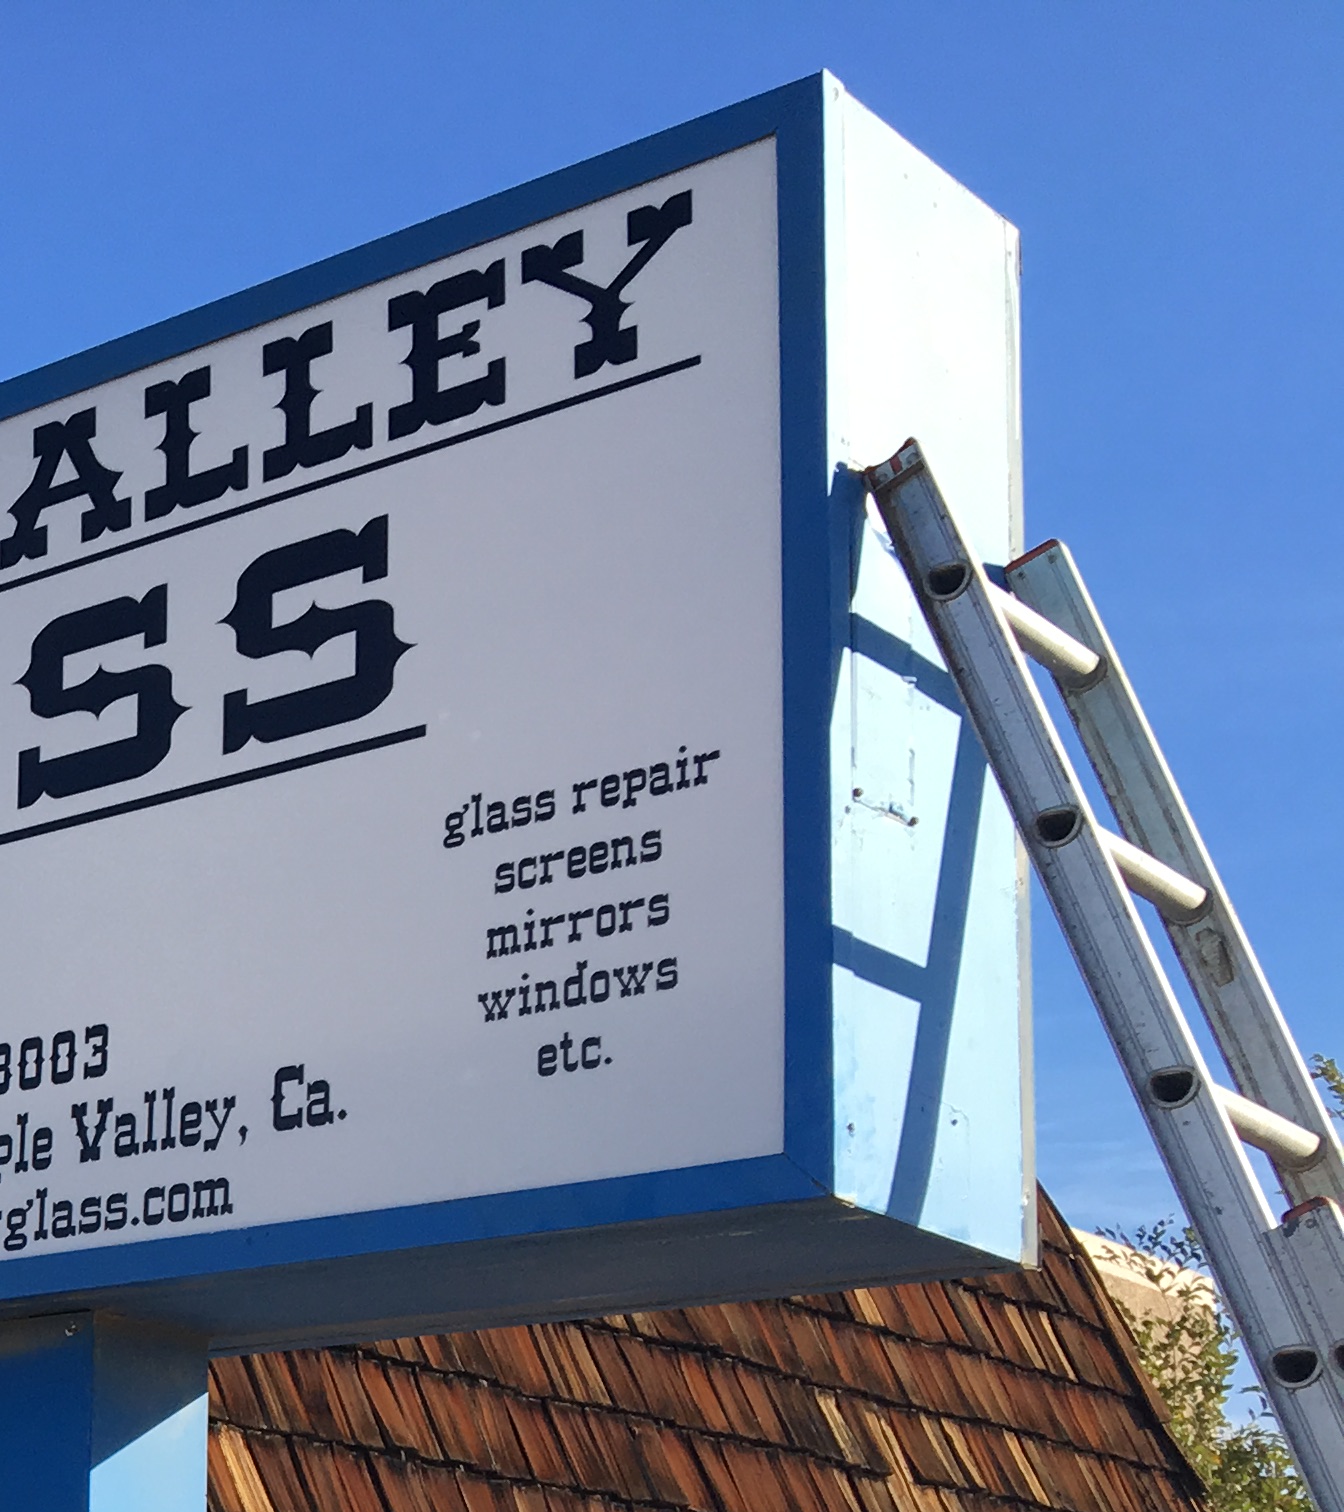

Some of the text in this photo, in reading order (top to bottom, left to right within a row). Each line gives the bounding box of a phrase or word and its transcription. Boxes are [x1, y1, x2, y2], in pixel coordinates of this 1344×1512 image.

[443, 750, 720, 848] glass repair
[495, 830, 661, 894] screens
[487, 894, 669, 959] mirrors
[478, 957, 677, 1022] windows
[538, 1032, 612, 1076] etc.
[71, 1087, 249, 1163] Valley,
[271, 1064, 347, 1131] Ca.
